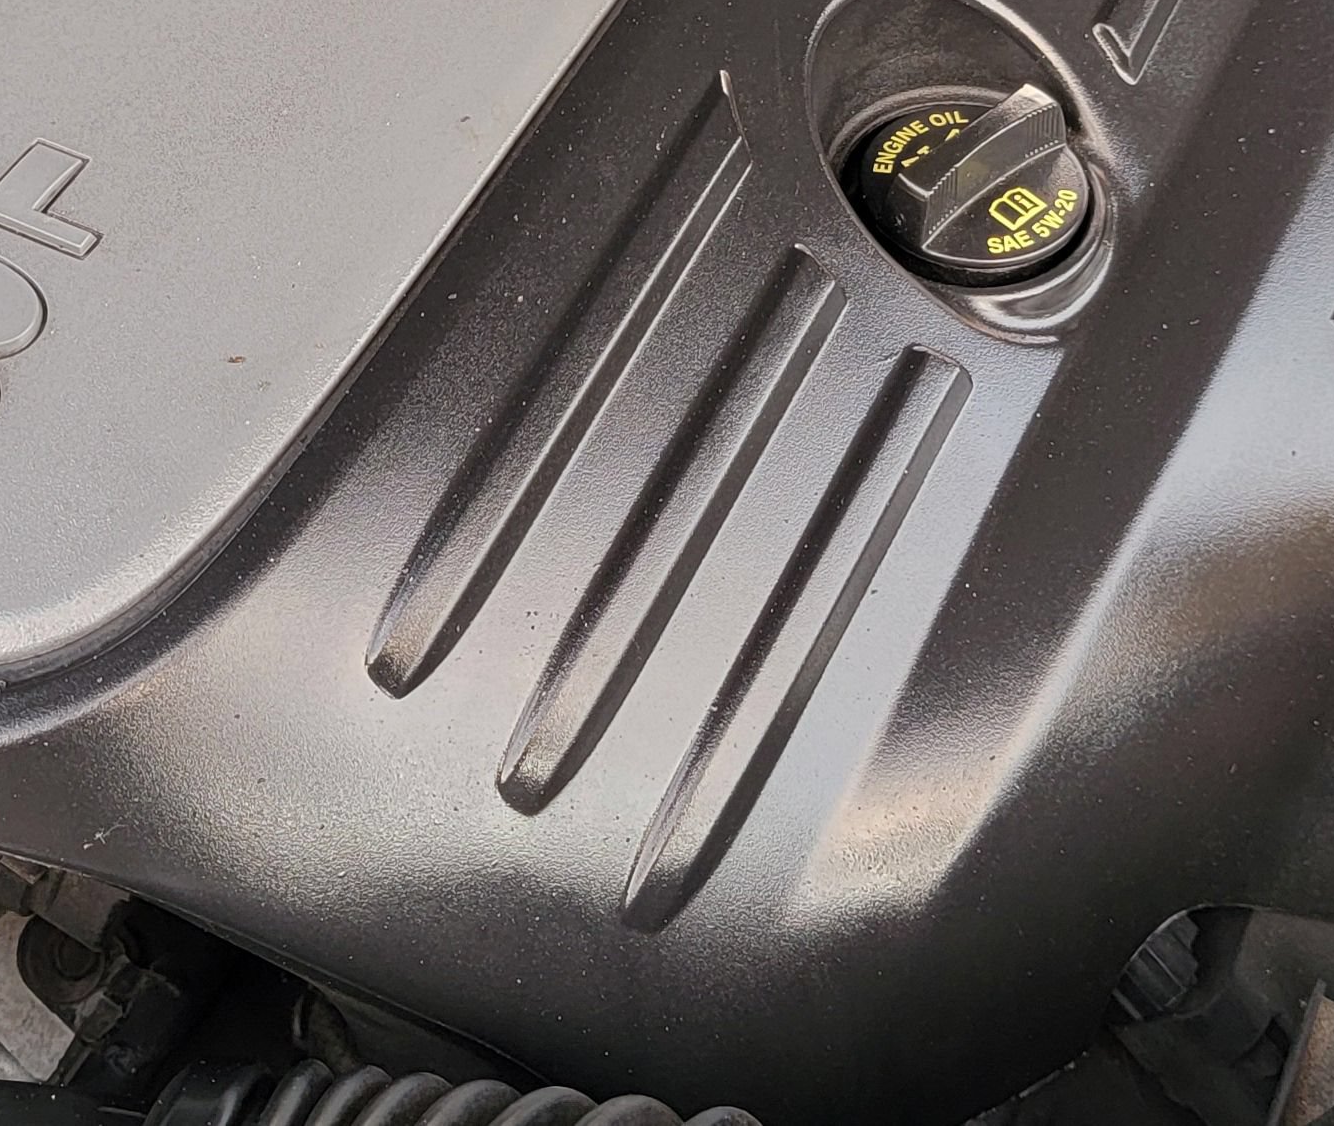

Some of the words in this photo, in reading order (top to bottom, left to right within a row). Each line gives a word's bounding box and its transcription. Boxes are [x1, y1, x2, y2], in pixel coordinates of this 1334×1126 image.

[872, 119, 929, 174] ENGINE
[929, 110, 969, 127] OIL
[987, 230, 1034, 255] SAE
[1034, 189, 1078, 238] 5W-20
